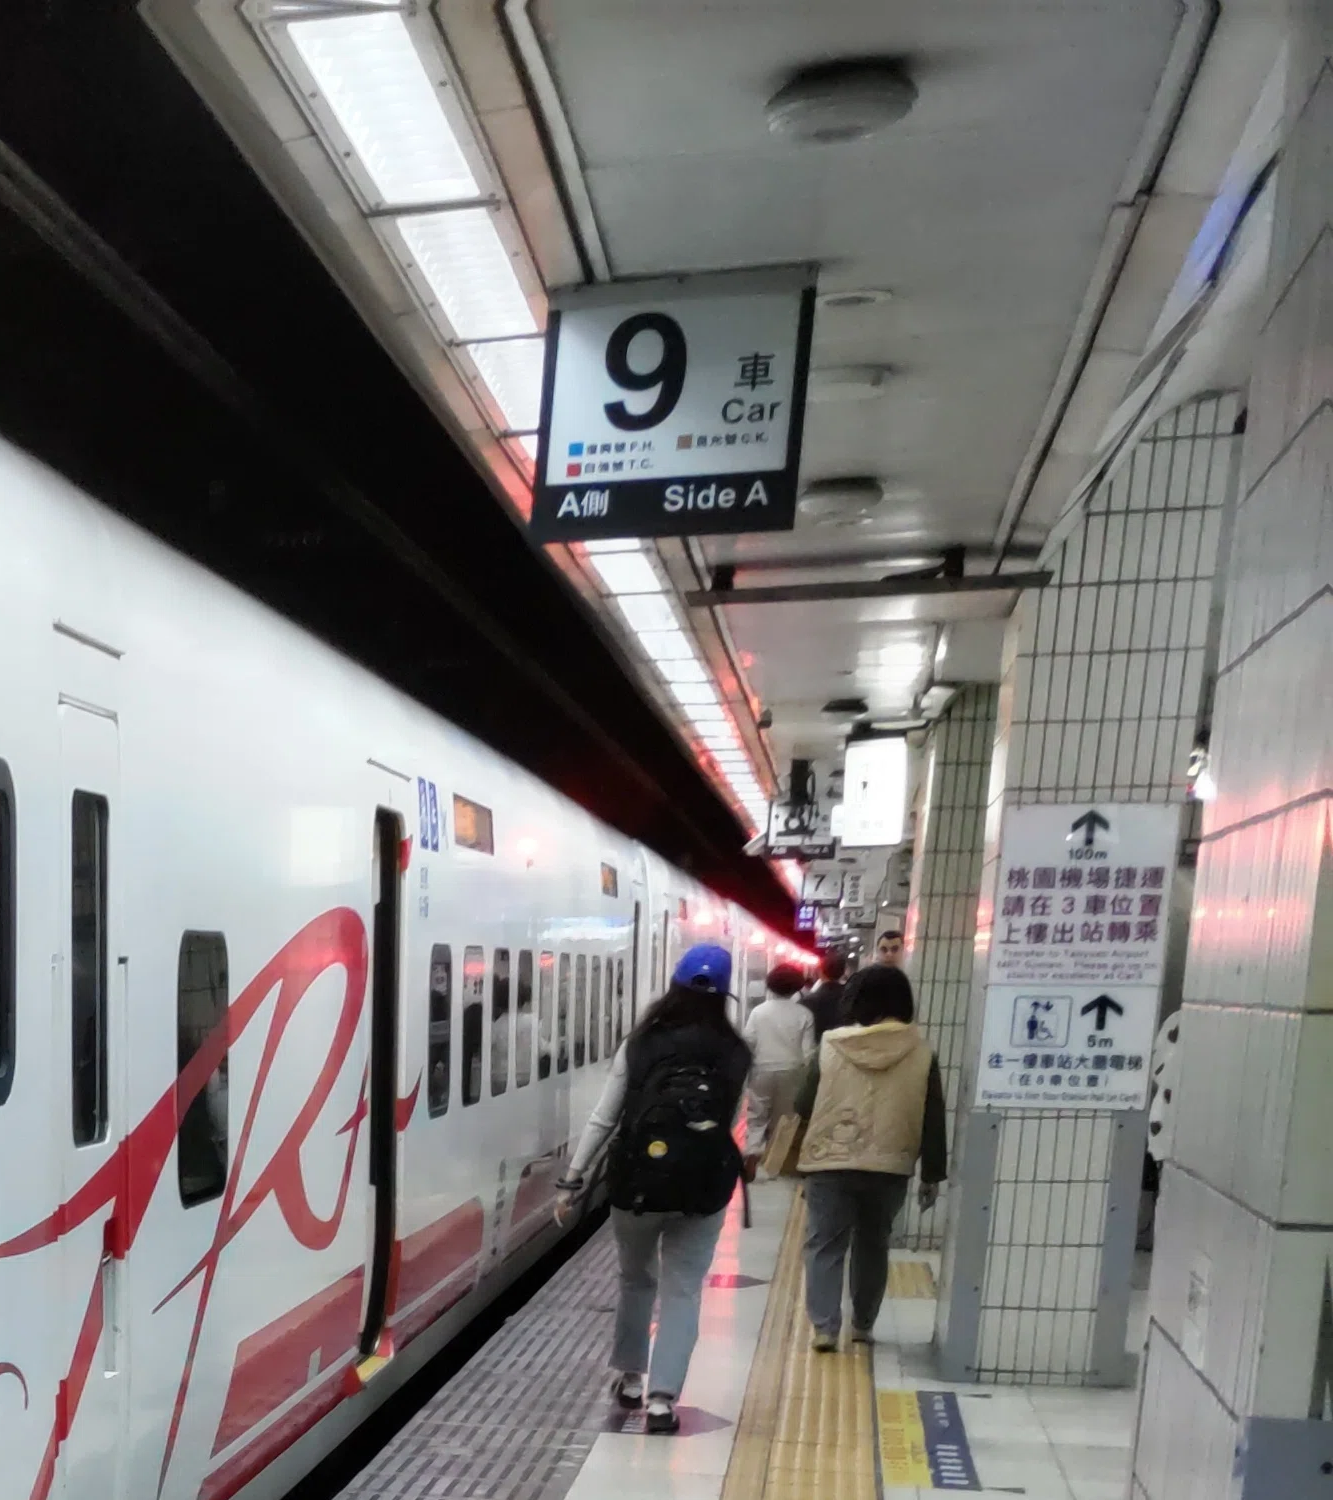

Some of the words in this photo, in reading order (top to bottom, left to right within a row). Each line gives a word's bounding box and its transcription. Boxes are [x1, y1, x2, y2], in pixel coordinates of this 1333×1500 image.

[603, 312, 687, 431] 9
[733, 351, 775, 391] 車
[721, 398, 782, 424] Car
[556, 489, 610, 518] A側
[663, 483, 736, 513] Side
[744, 478, 769, 507] A
[1068, 847, 1108, 860] 100m
[814, 873, 827, 892] 7
[1007, 866, 1165, 889] 桃園機場捷運
[1087, 1034, 1114, 1049] 5m
